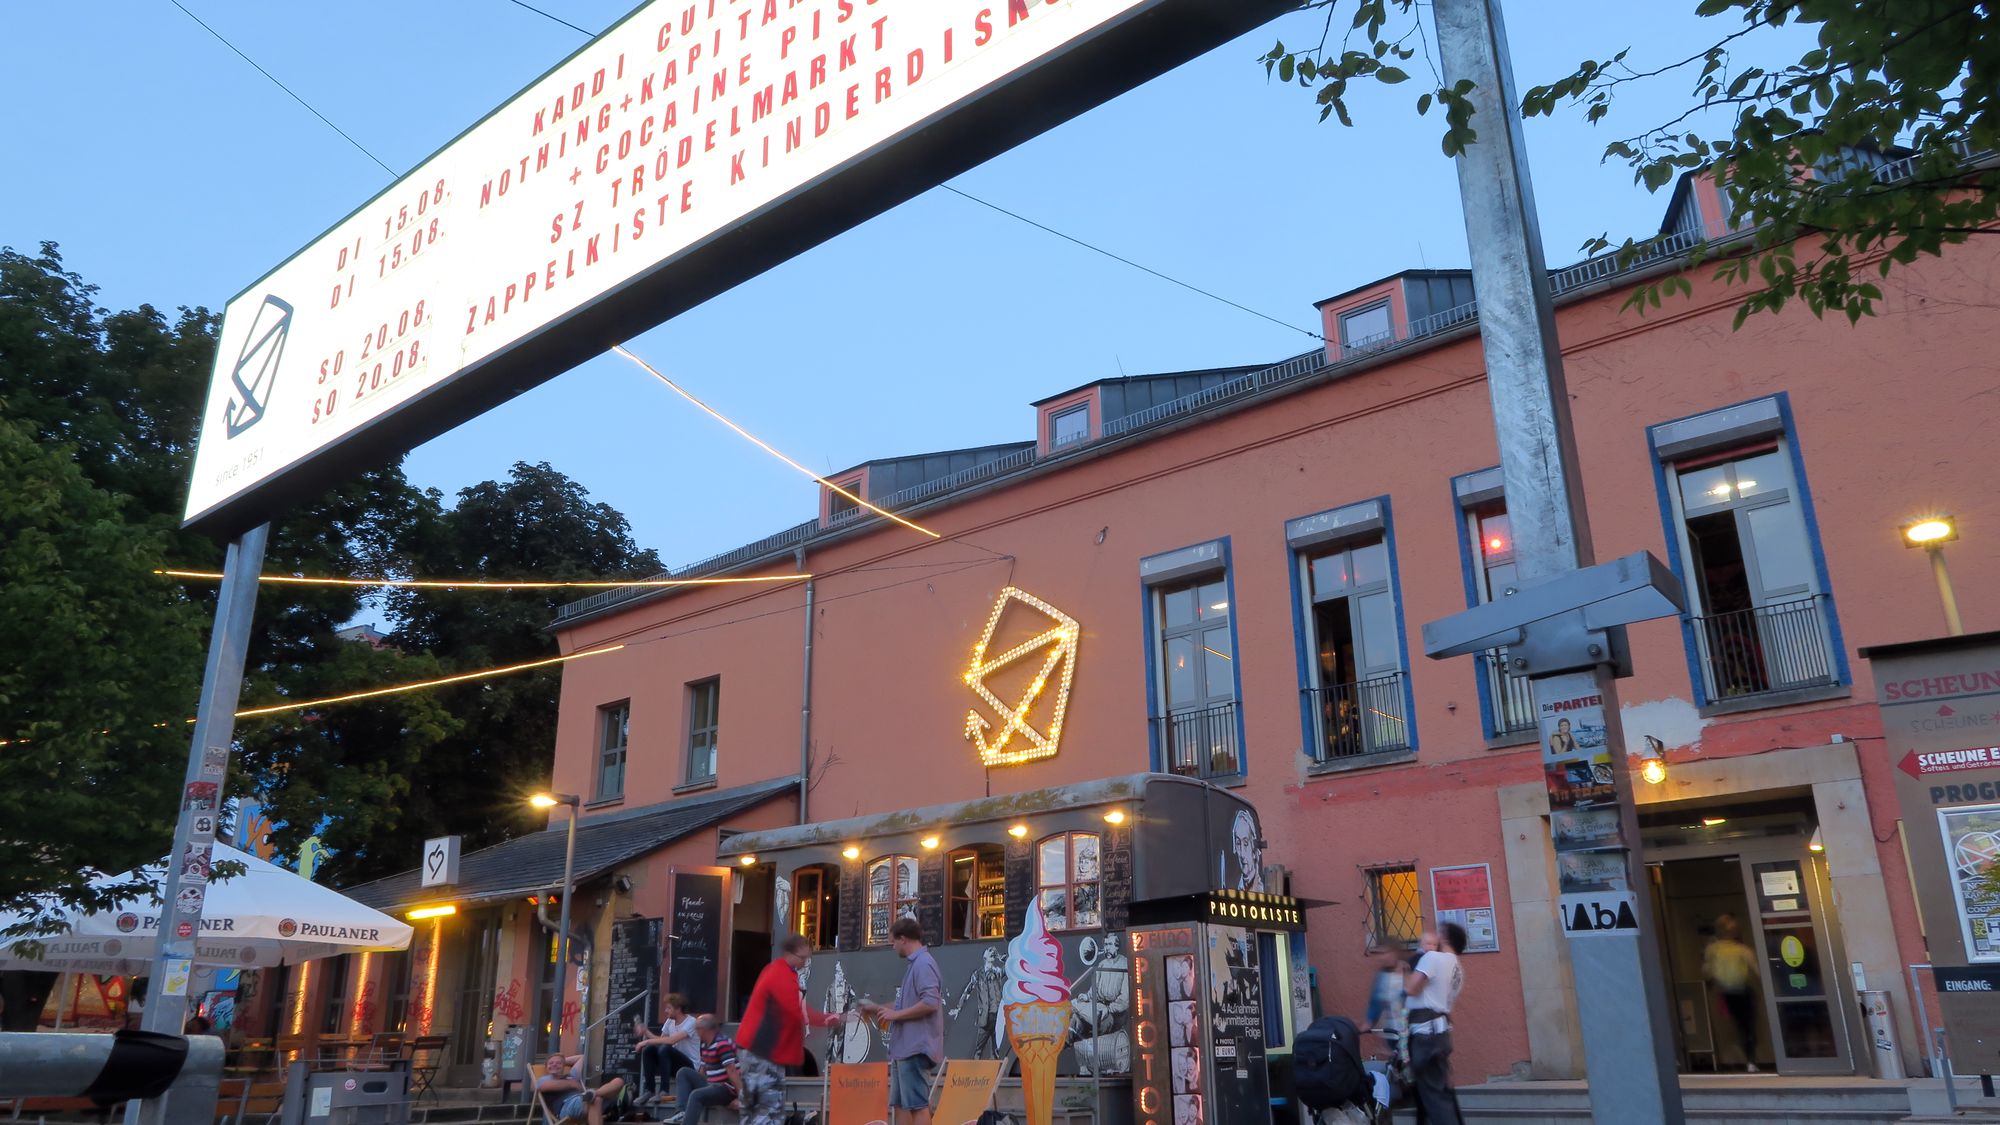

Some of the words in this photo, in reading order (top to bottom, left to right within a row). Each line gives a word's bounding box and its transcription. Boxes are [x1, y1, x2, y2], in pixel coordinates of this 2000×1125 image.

[780, 0, 880, 61] PIS
[330, 275, 355, 309] DI
[378, 217, 446, 278] 15.08.
[479, 0, 804, 209] NOTHING+KAPITA
[337, 237, 361, 272] DI
[385, 178, 451, 240] 15.08.
[531, 53, 626, 138] KADDI
[318, 351, 345, 385] SO
[360, 300, 431, 361] 20.08.
[550, 200, 585, 245] SZ
[610, 16, 889, 209] TRÖDELMARKT
[311, 389, 337, 425] SO
[354, 340, 426, 401] 20.08.
[465, 180, 694, 336] ZAPPELKISTE
[730, 0, 1062, 187] KINDERDISK
[242, 446, 265, 471] 1951
[1542, 703, 1553, 712] Die
[1553, 695, 1603, 713] PARTEI
[1918, 748, 1987, 767] SCHEUNE
[1952, 762, 1966, 770] und
[1210, 900, 1299, 924] PHOTOKISTE
[301, 922, 380, 942] PAULANER
[1136, 934, 1145, 950] 2
[1945, 979, 1992, 992] EINGANG:
[1245, 1026, 1262, 1040] Folge
